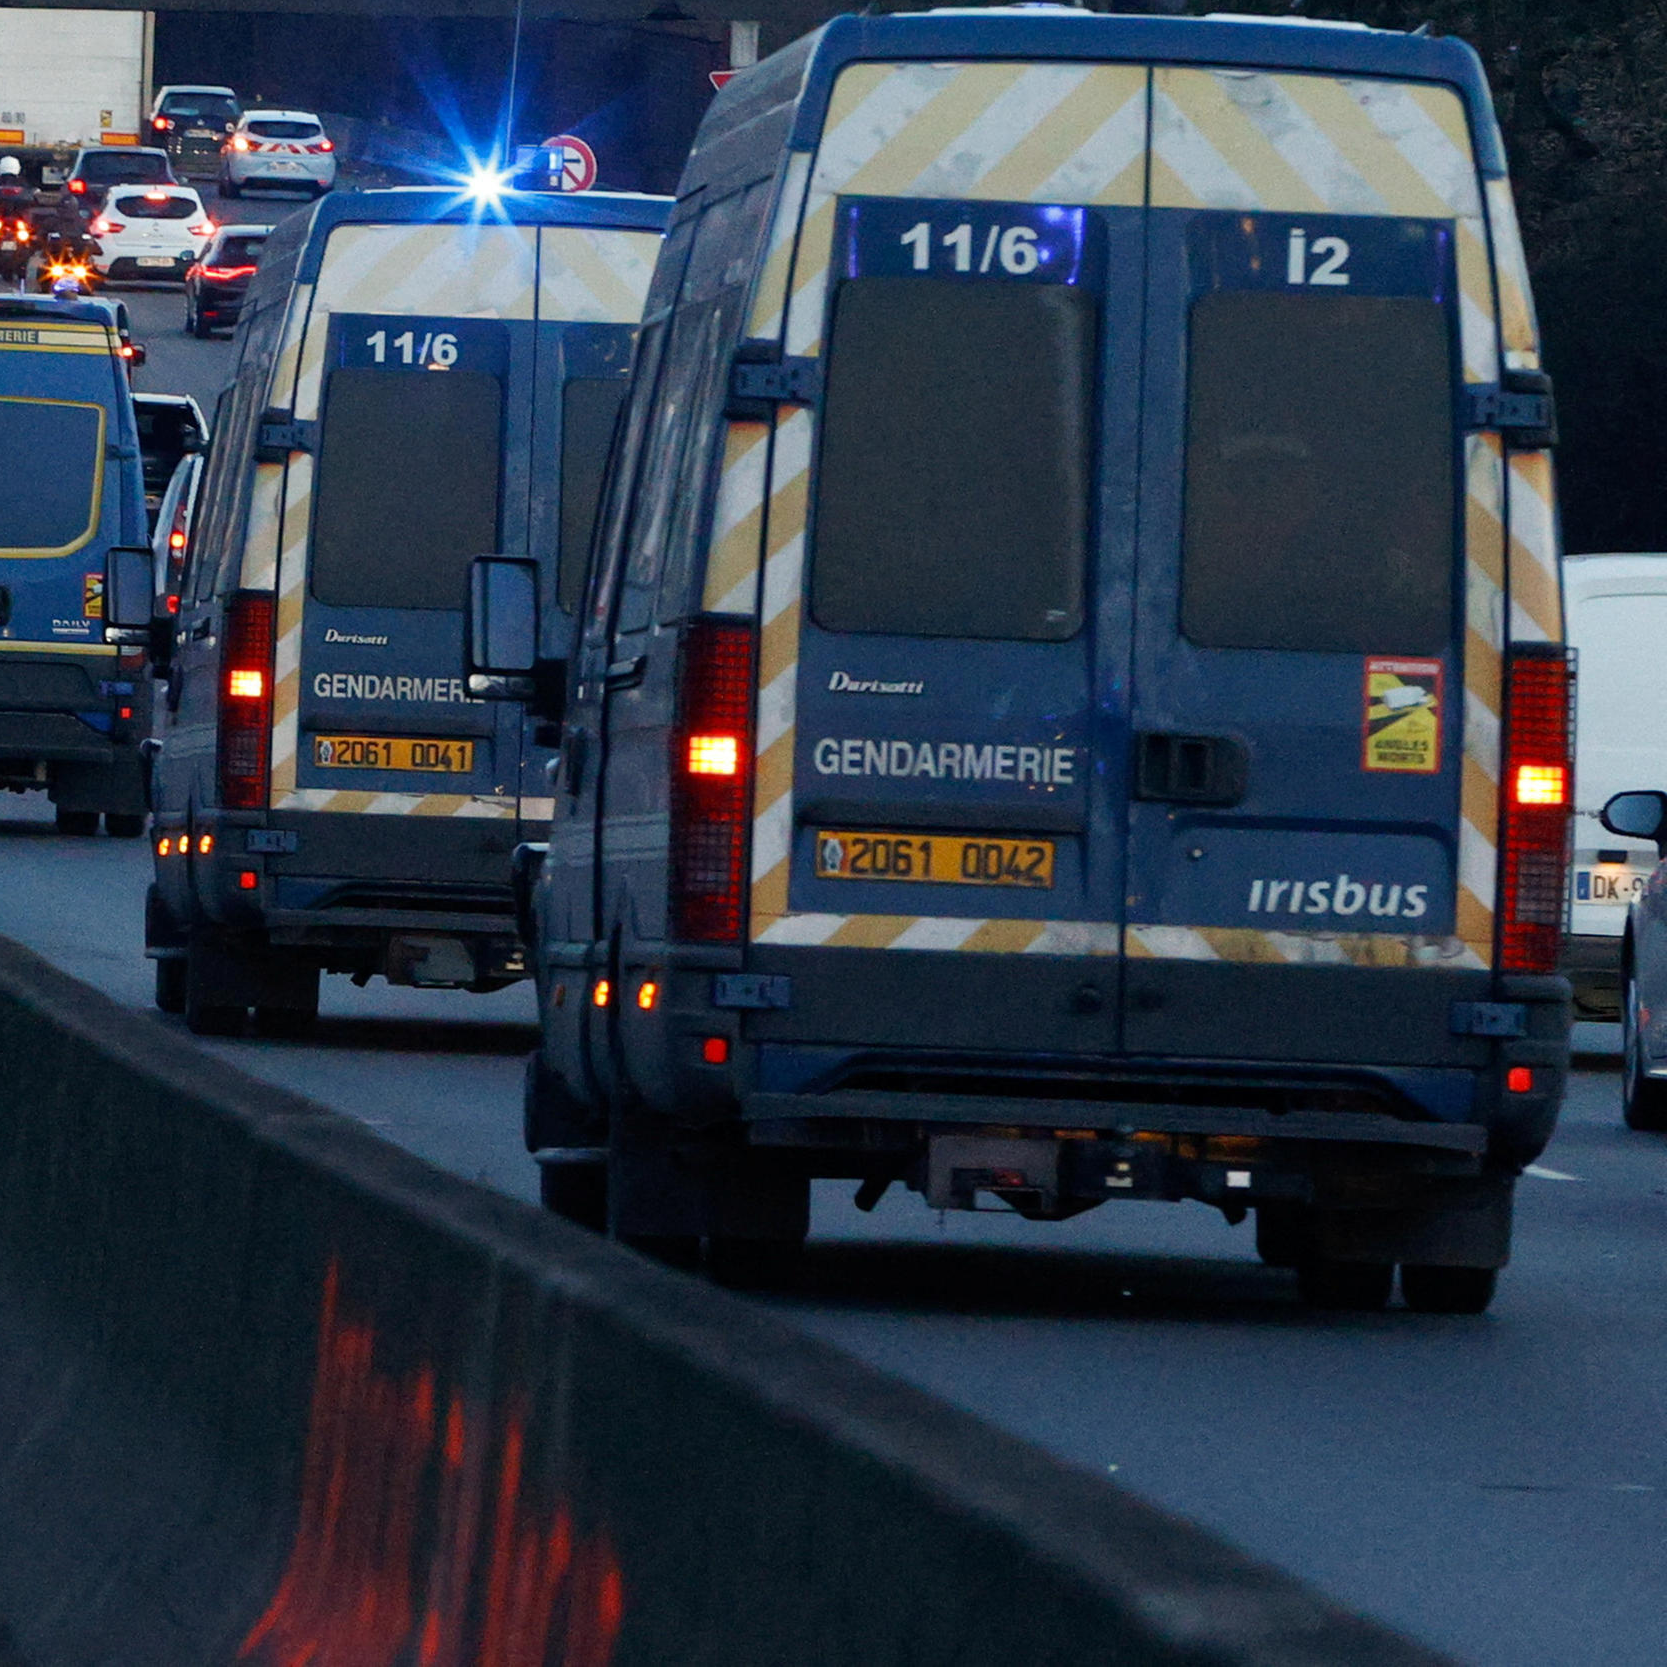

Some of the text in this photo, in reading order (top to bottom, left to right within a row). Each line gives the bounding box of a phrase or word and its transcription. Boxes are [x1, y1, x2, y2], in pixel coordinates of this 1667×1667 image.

[900, 222, 1040, 274] 11/6
[366, 330, 459, 367] 11/6
[313, 672, 485, 704] GENDARMER
[337, 740, 467, 770] 2061 0041
[814, 738, 1076, 784] GENDARMERIE
[850, 838, 1046, 884] 2061 0042
[1247, 874, 1429, 918] irisbus
